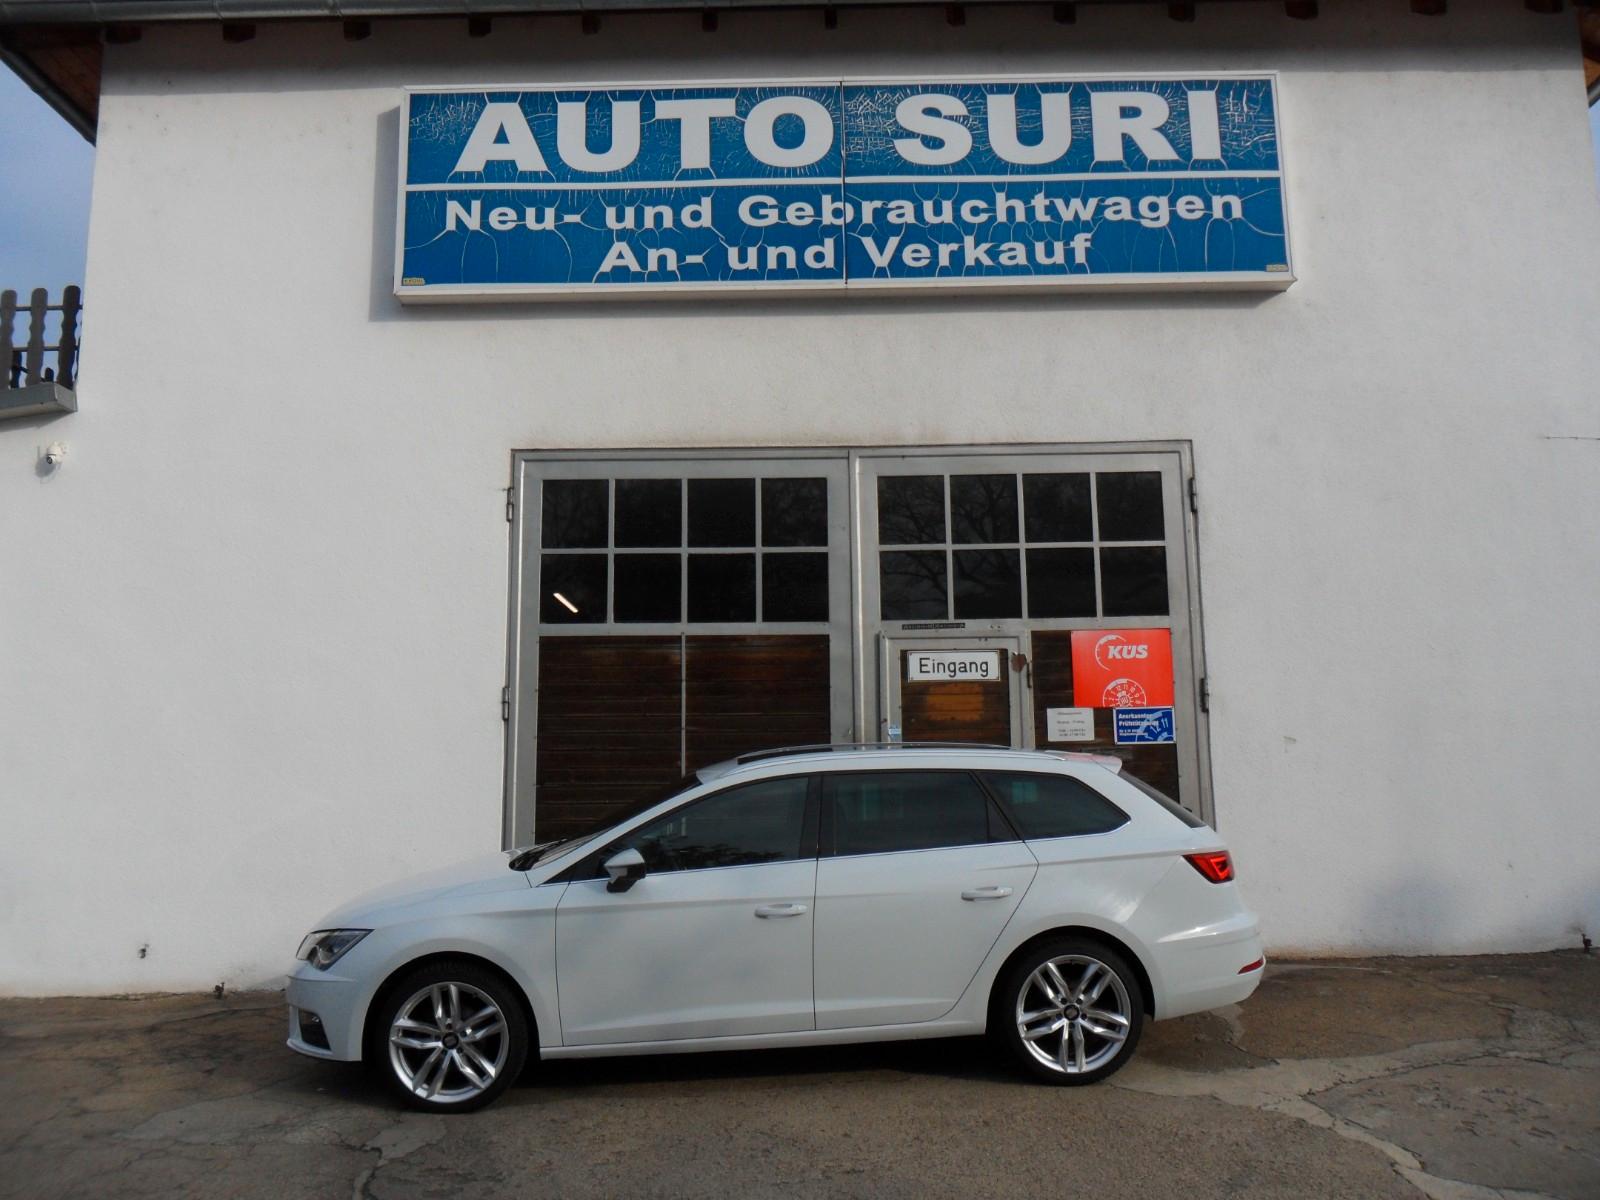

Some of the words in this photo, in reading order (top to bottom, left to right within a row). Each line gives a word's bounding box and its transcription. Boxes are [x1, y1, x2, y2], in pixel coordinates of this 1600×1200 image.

[454, 95, 834, 172] AUTO
[892, 90, 1222, 166] SURI
[445, 200, 583, 231] Neu-
[604, 196, 713, 230] und
[737, 191, 1242, 228] Gebrauchtwagen
[597, 241, 704, 272] An-
[727, 238, 836, 271] und
[860, 232, 1092, 267] Verkauf
[919, 657, 989, 678] Eingang
[1107, 644, 1148, 659] KÜS
